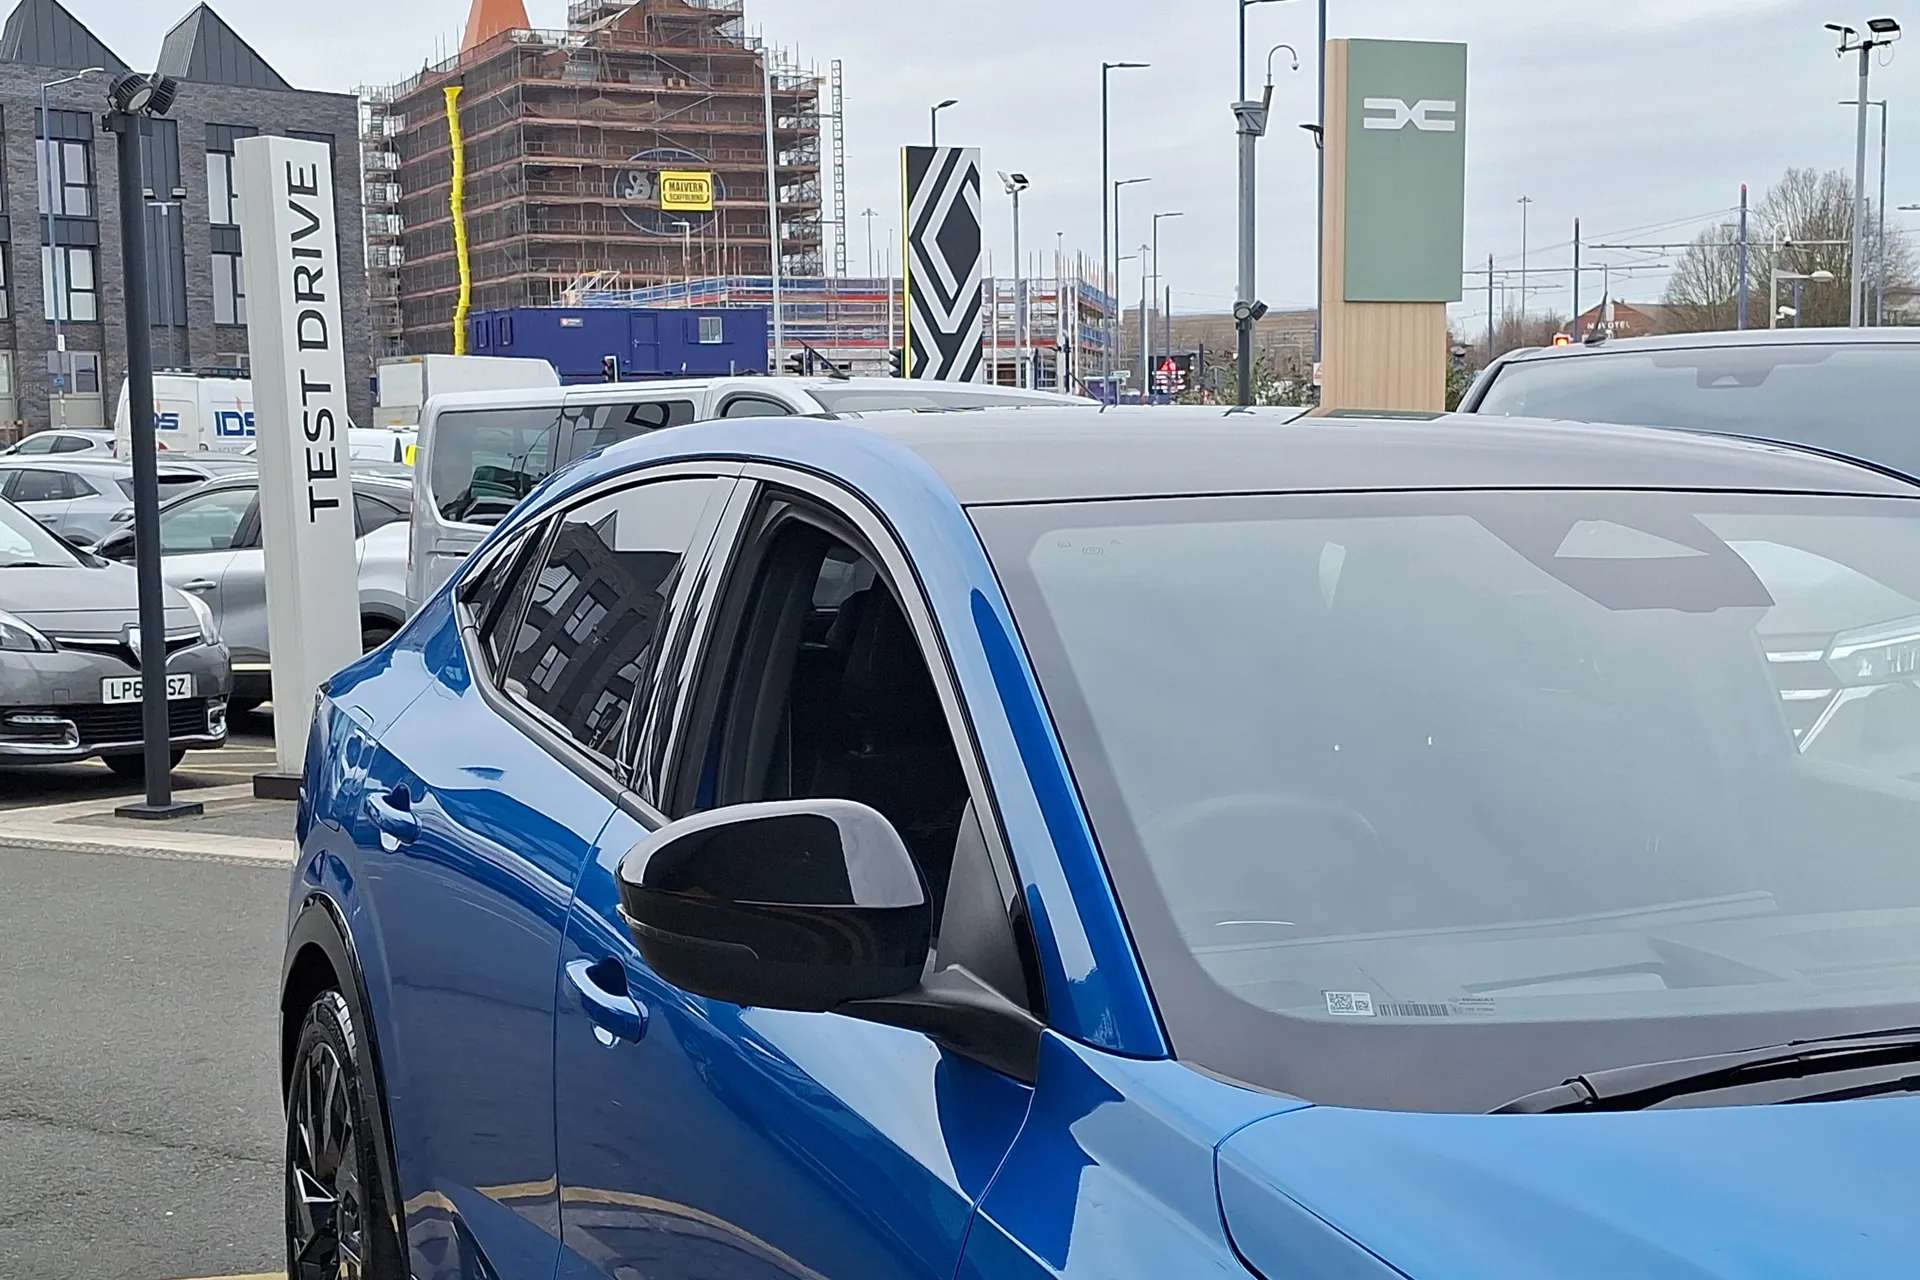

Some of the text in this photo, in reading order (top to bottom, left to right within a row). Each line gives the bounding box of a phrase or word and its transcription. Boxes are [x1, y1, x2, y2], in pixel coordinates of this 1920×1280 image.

[668, 181, 704, 193] MALVERN
[285, 160, 341, 524] TEST DRIVE
